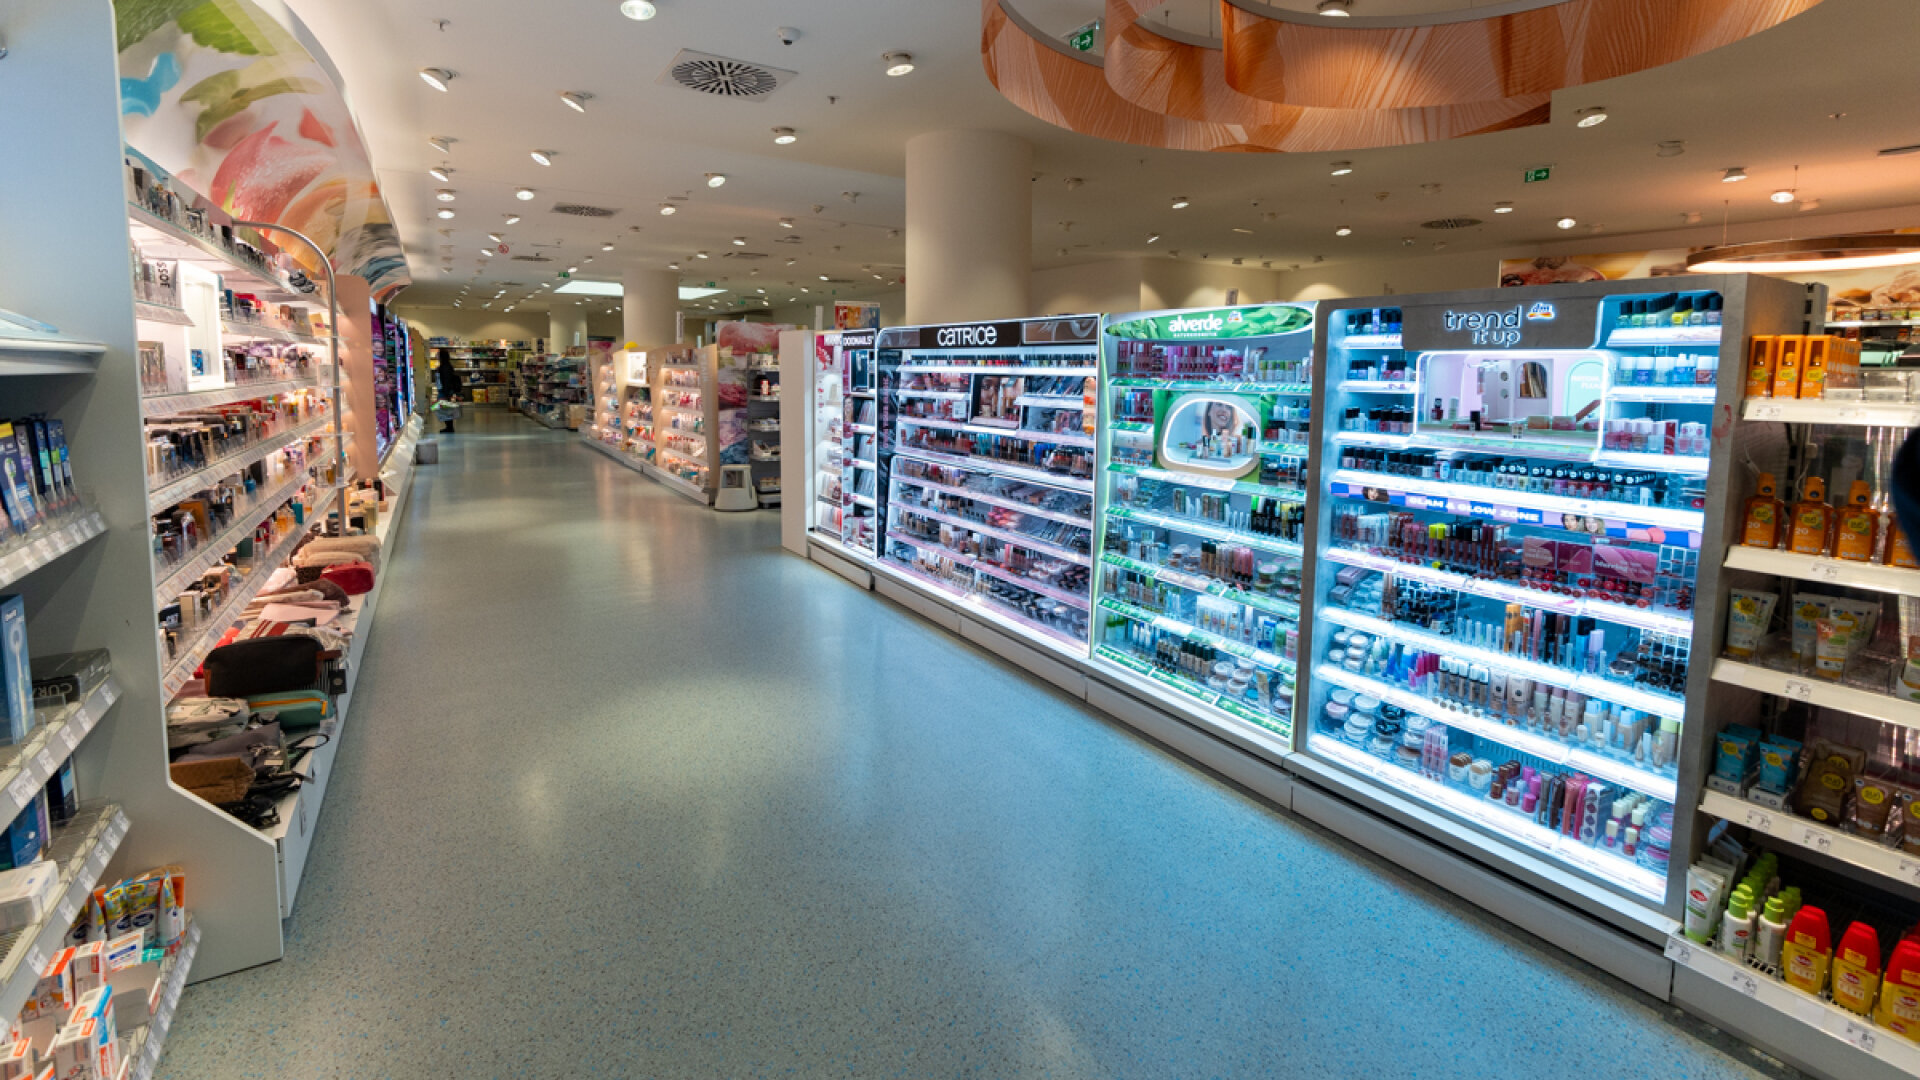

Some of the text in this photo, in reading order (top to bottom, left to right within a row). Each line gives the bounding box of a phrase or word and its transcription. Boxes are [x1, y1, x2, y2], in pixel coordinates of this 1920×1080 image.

[1168, 313, 1223, 332] alverde
[1444, 304, 1522, 331] trend
[1472, 329, 1521, 348] it up
[1457, 503, 1496, 516] GLOW
[1499, 509, 1539, 523] ZONE
